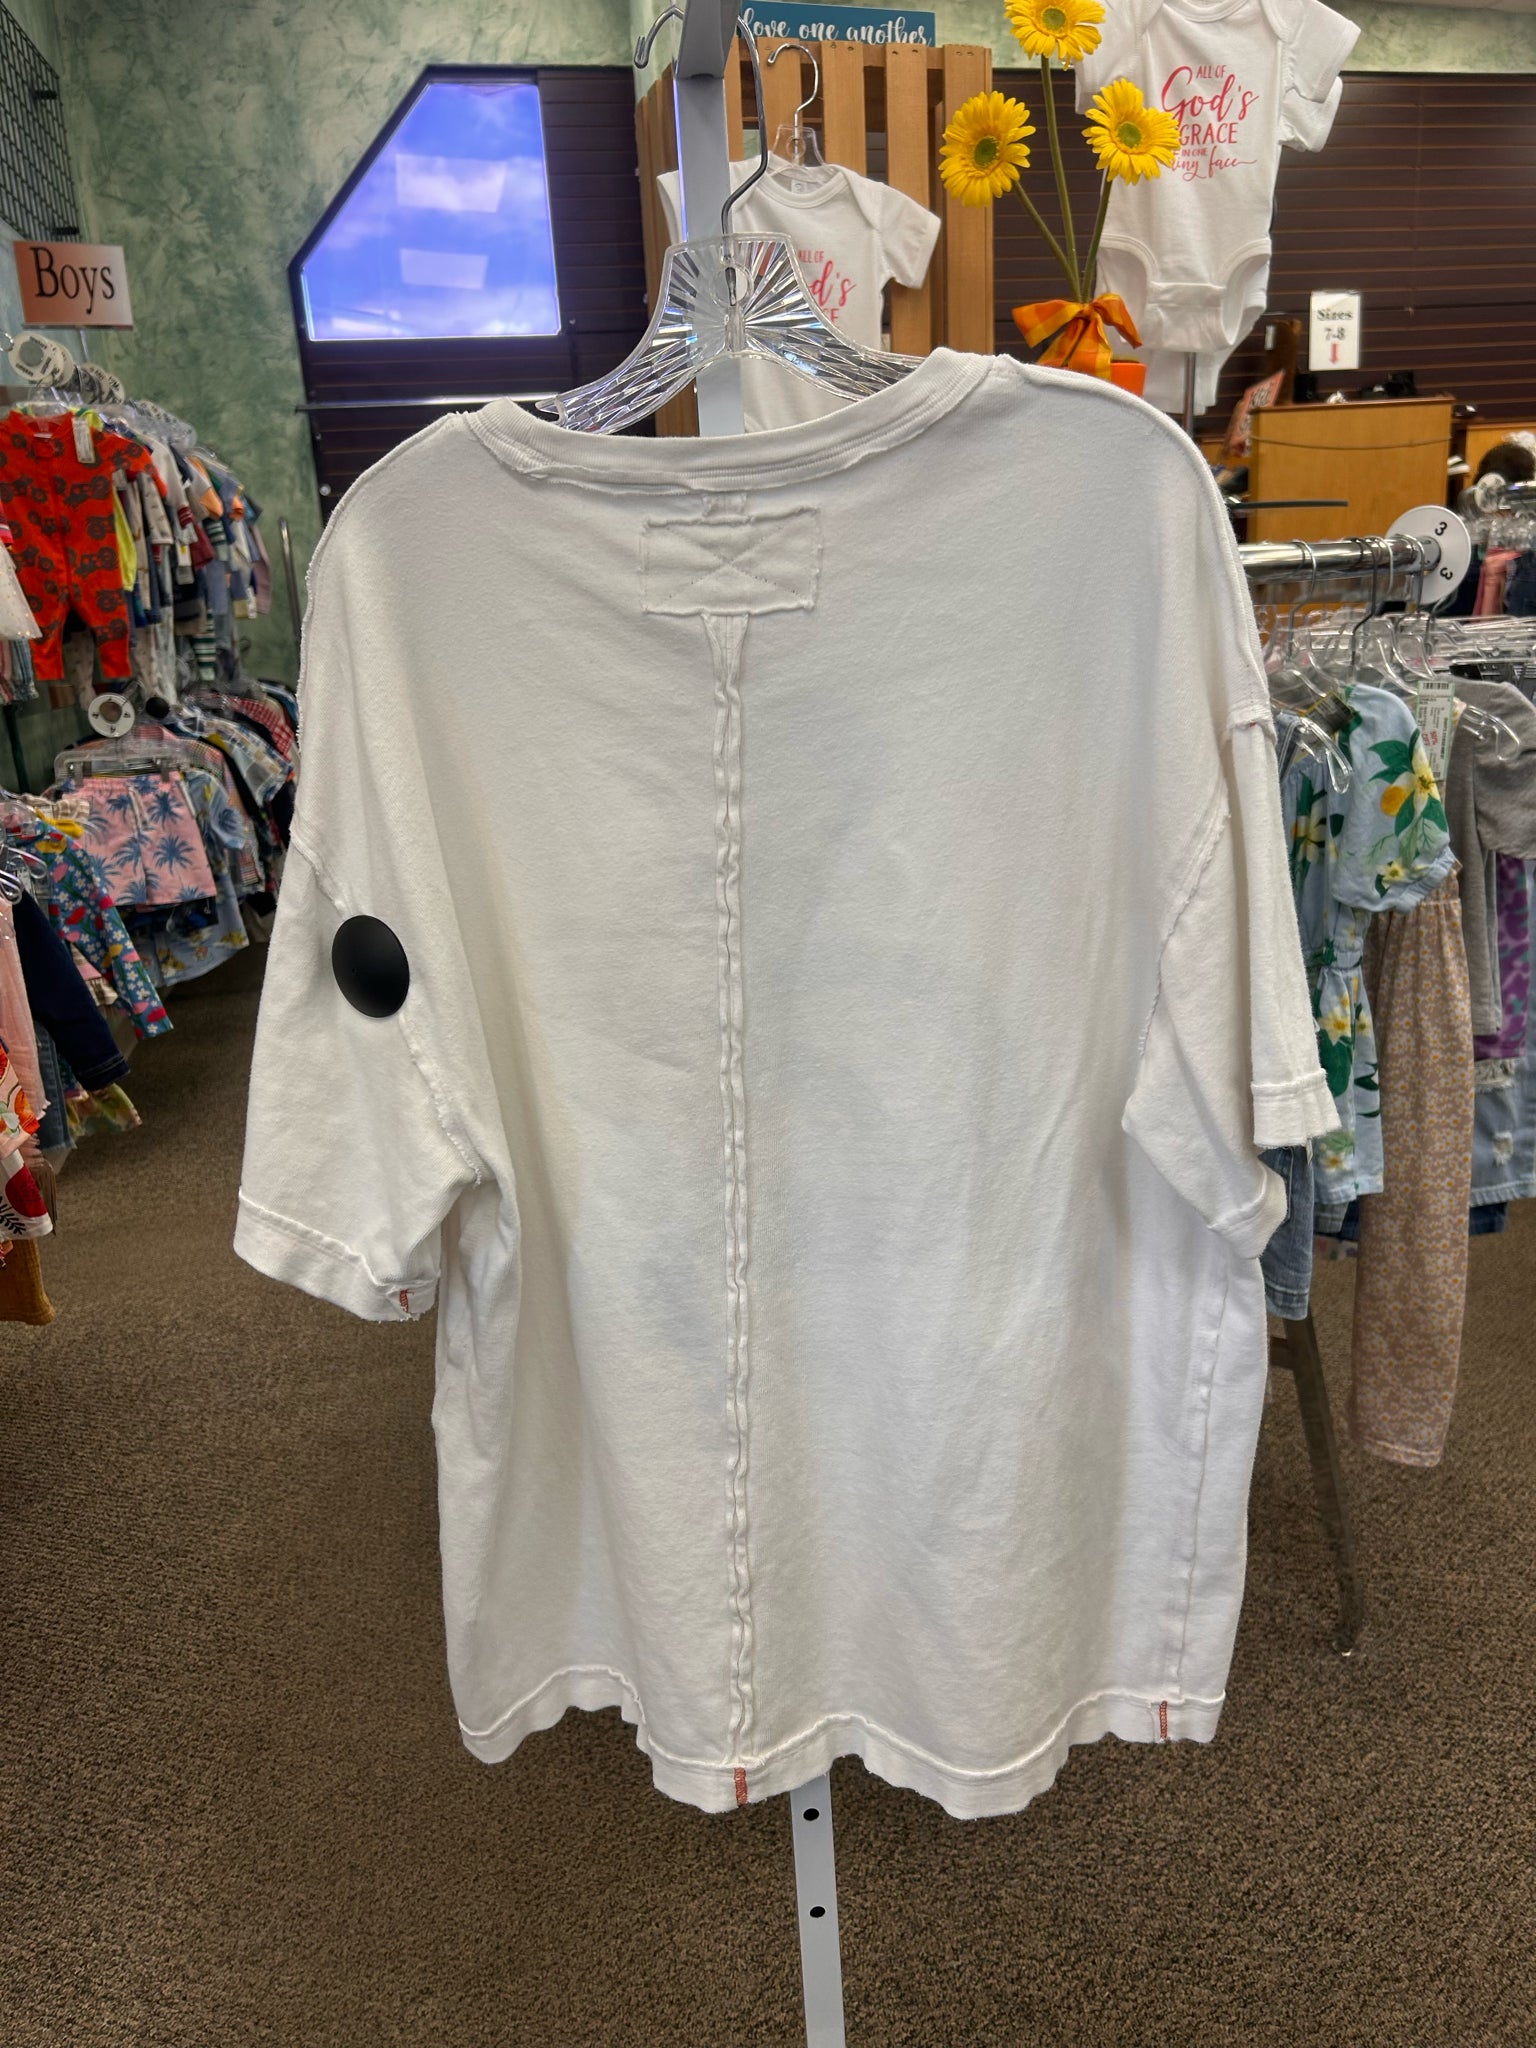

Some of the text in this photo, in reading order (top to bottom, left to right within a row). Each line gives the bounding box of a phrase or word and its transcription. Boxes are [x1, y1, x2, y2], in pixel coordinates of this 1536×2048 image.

[742, 8, 933, 47] love one another
[1196, 65, 1227, 79] ALL OF
[1161, 66, 1259, 127] God's
[1179, 123, 1239, 146] GRACE
[1208, 145, 1258, 178] face
[29, 247, 115, 315] Boys
[809, 260, 857, 307] d's
[1317, 308, 1353, 321] Sizes
[1324, 327, 1346, 341] 7-8
[1434, 521, 1448, 536] 3
[1440, 567, 1453, 581] 3
